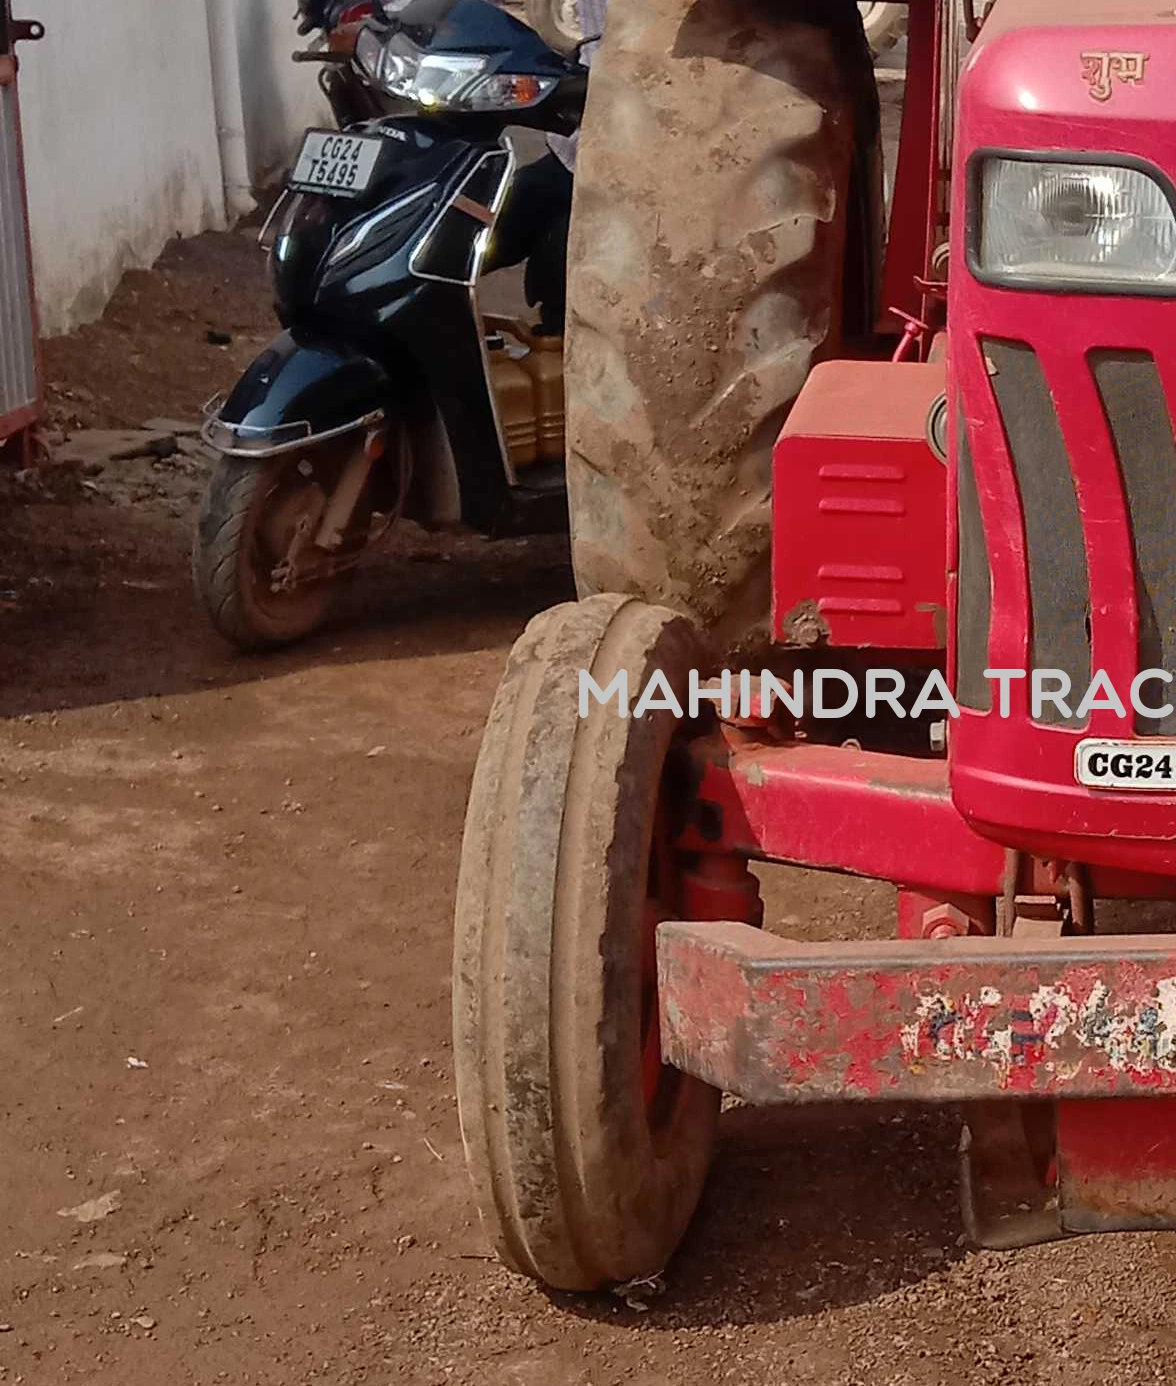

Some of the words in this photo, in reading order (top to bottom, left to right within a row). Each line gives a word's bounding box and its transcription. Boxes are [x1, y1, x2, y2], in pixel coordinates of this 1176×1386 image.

[1081, 52, 1149, 101] शुभ
[321, 136, 363, 162] CG24
[307, 159, 358, 187] T5495
[1087, 752, 1172, 779] CG24
